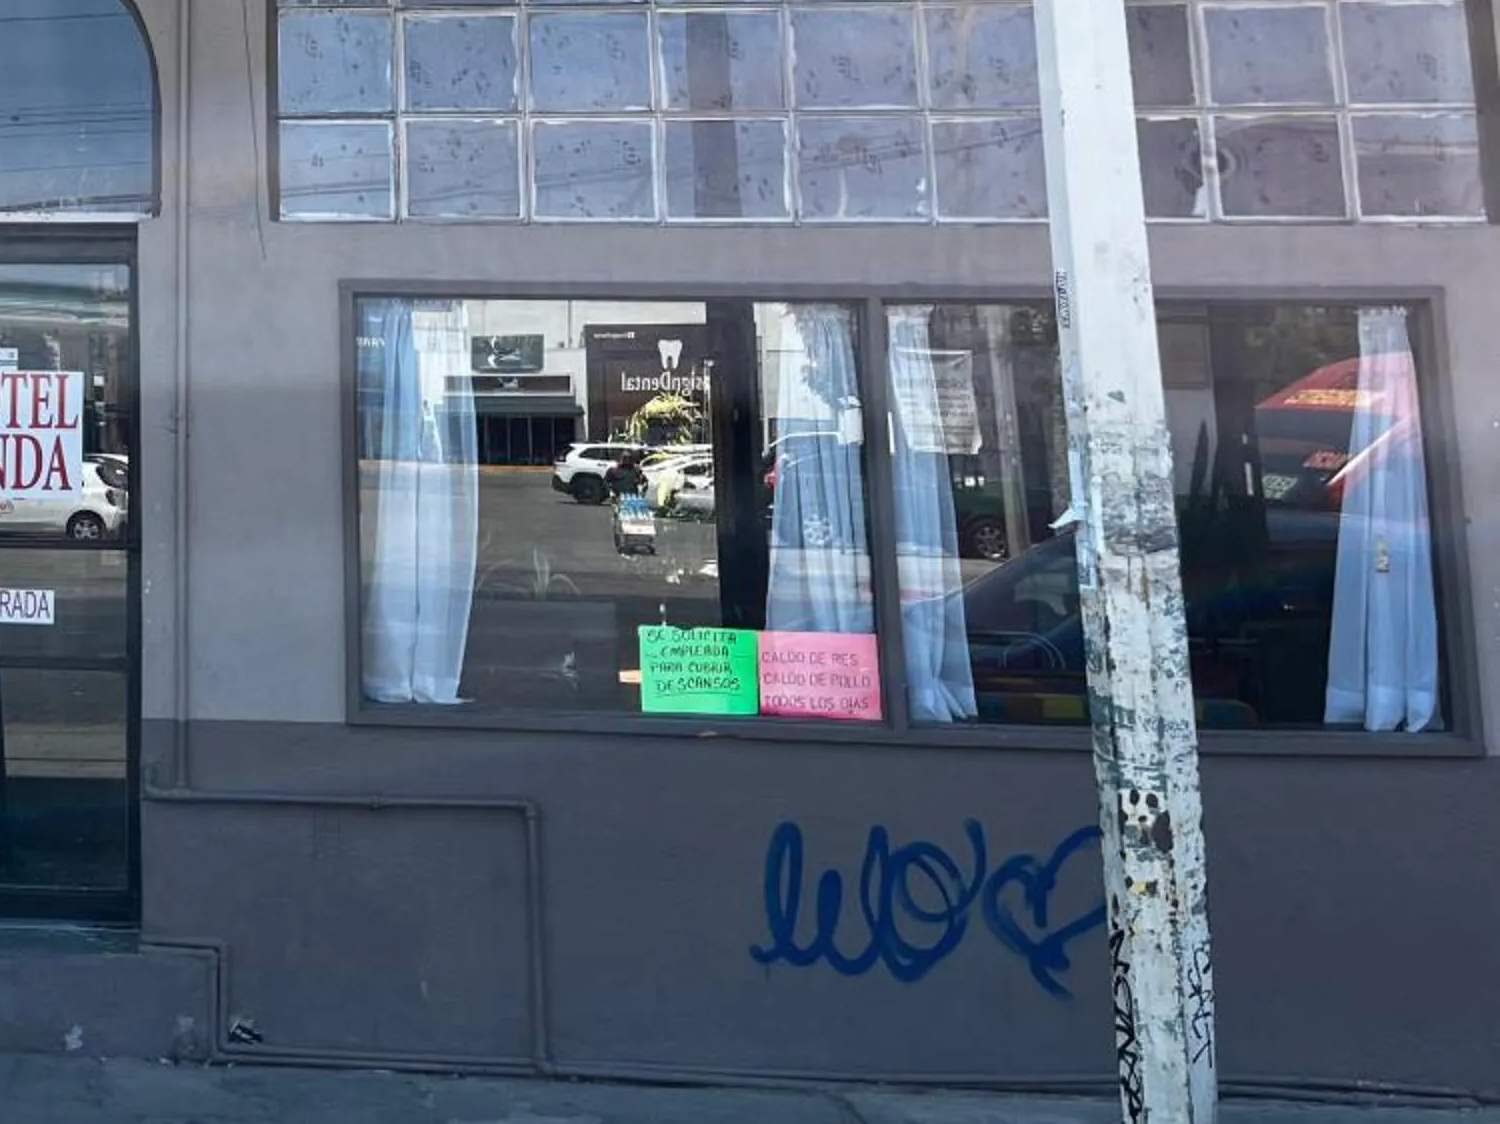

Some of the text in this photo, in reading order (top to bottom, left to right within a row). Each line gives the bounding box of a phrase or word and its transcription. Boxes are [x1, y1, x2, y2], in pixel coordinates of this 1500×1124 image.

[762, 650, 859, 667] CALDO DE RES
[650, 661, 684, 674] PARA
[655, 676, 741, 692] DESCANSOS
[763, 671, 872, 689] CALDO DE POLLO
[764, 694, 805, 709] TODOS
[809, 696, 835, 711] LOS
